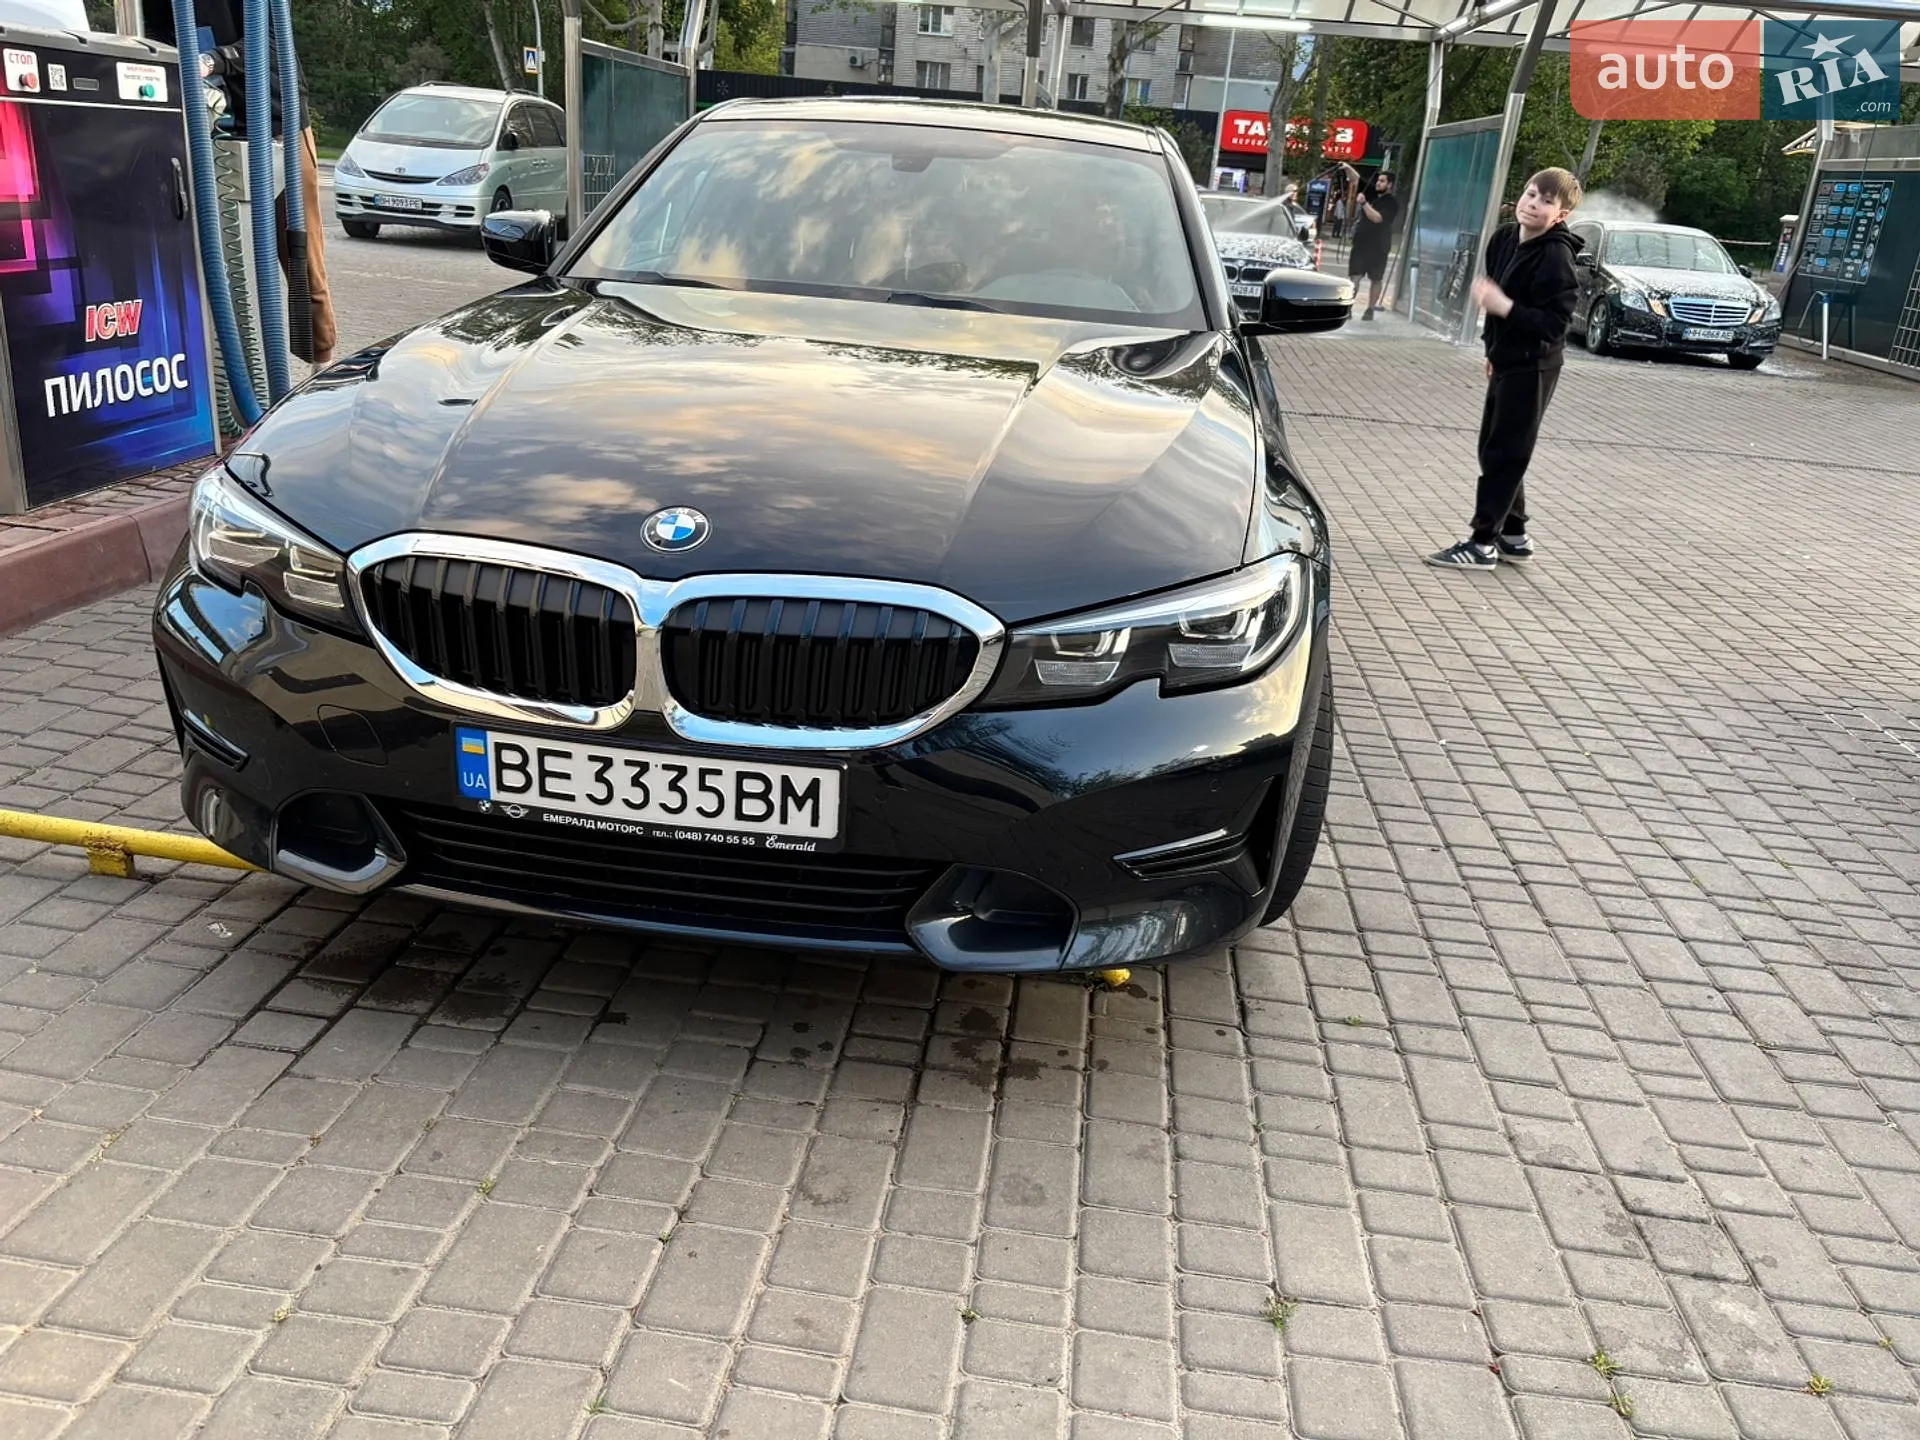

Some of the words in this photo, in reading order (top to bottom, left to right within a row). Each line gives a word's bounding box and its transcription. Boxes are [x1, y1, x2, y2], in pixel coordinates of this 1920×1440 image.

[8, 52, 34, 65] СТОП
[85, 299, 143, 342] ICW
[44, 353, 188, 417] ПИЛОСОС
[463, 771, 487, 789] UA
[542, 813, 595, 829] ЕМЕРАЛД
[596, 821, 644, 835] МОТОРС
[674, 829, 702, 841] (048)
[704, 833, 724, 843] 740
[726, 835, 740, 844] 55
[741, 836, 756, 845] 55
[765, 835, 816, 851] Emerald
